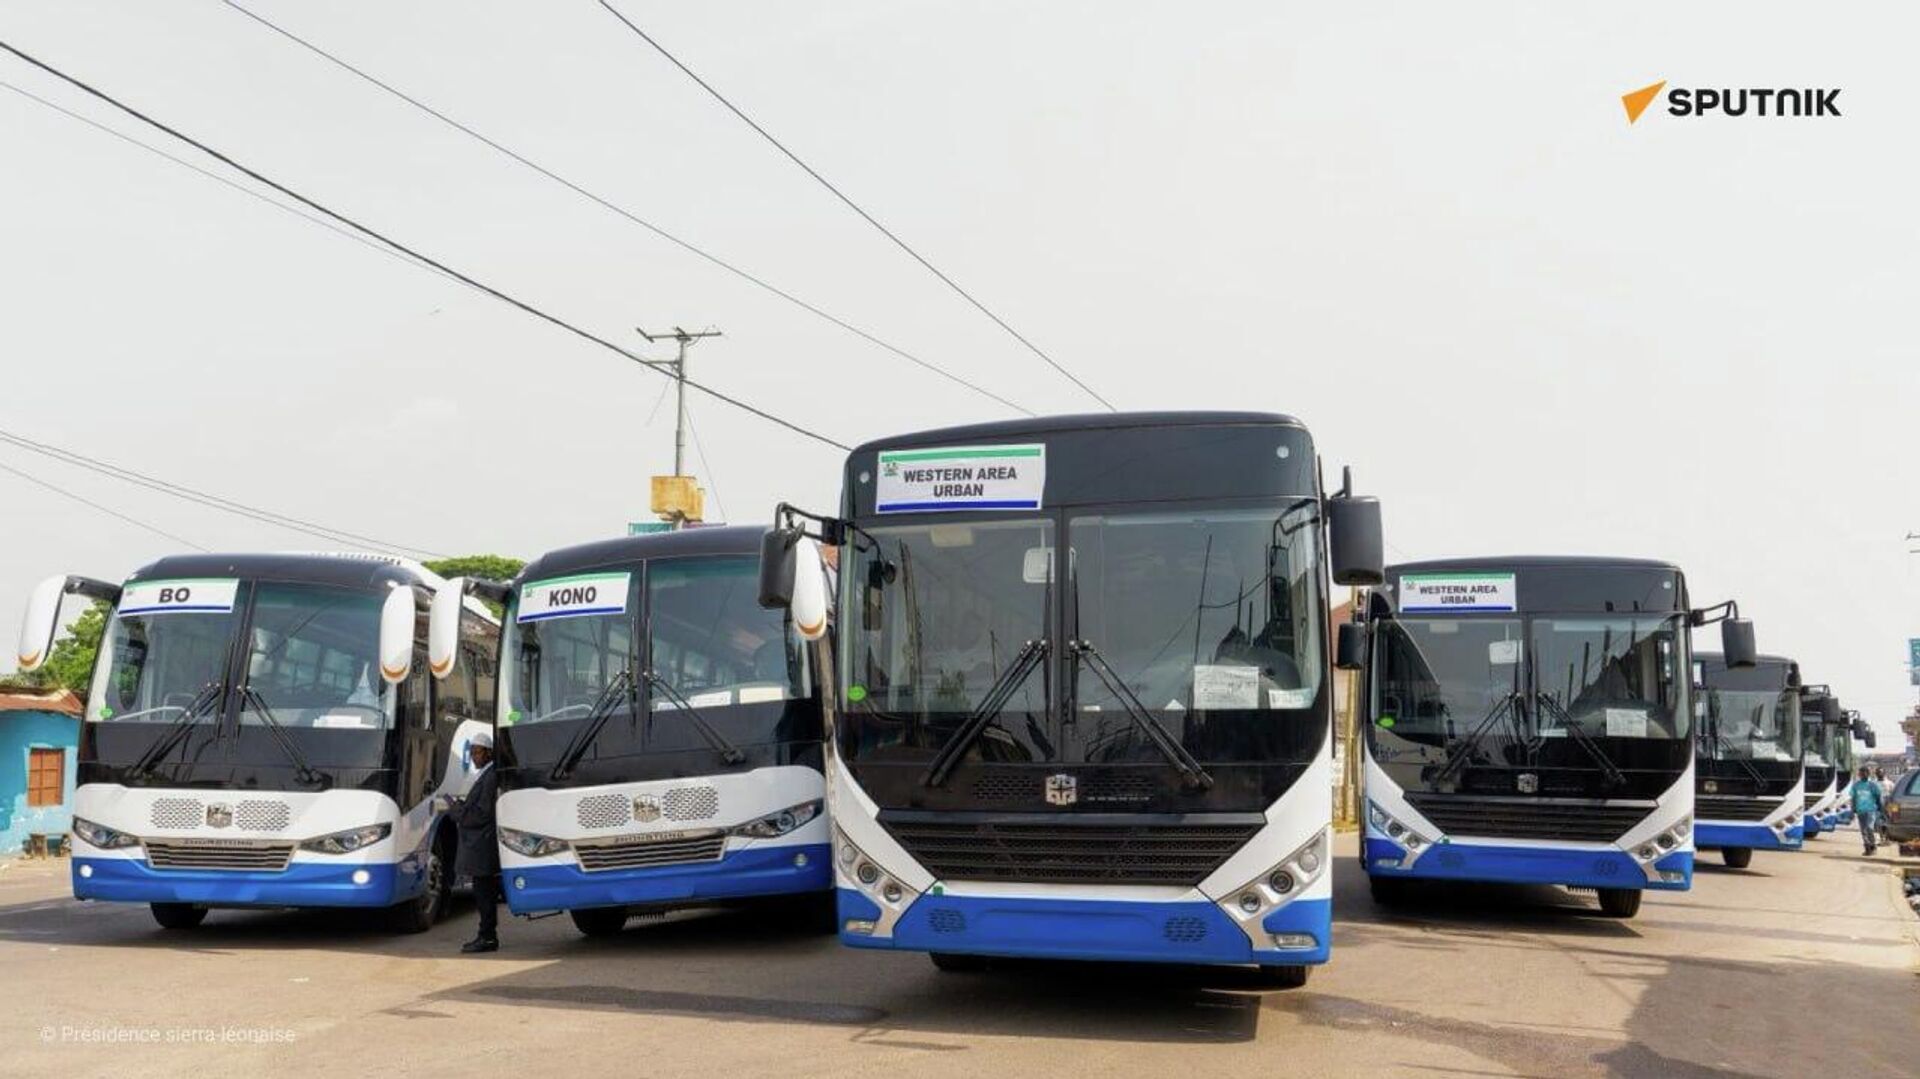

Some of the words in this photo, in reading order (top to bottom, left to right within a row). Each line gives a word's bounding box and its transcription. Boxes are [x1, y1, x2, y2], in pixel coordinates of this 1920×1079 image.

[904, 468, 972, 482] WESTERN
[977, 467, 1017, 480] AREA
[933, 484, 984, 497] URBAN
[159, 587, 190, 603] BO
[549, 587, 597, 606] KONO
[1420, 586, 1467, 594] WESTERN
[1470, 585, 1497, 594] AREA
[1440, 595, 1475, 604] URBAN
